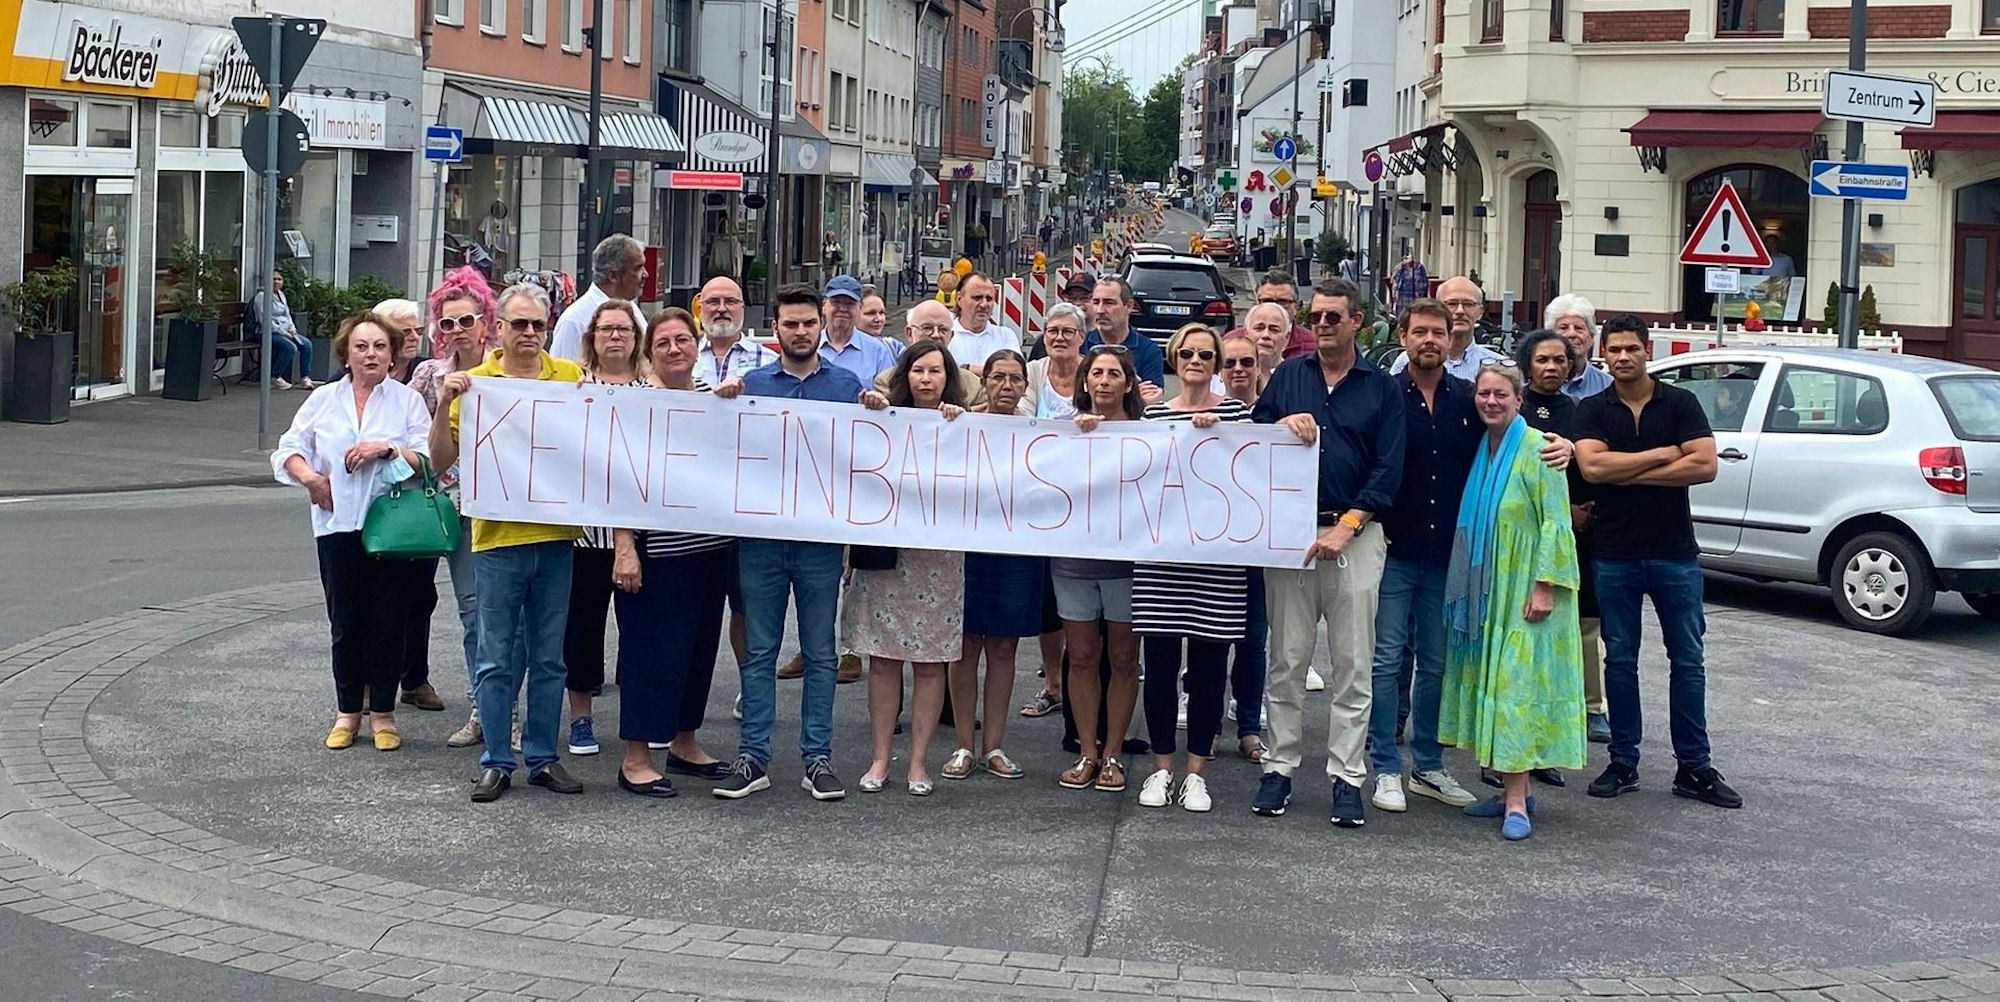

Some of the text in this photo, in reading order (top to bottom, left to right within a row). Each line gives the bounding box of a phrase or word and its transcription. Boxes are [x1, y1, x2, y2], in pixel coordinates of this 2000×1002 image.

[70, 25, 162, 83] Bäckerei
[1927, 71, 1956, 93] &
[986, 79, 996, 143] HOTEL
[1847, 87, 1904, 109] Zentrum
[323, 107, 384, 141] Immobilien
[1839, 175, 1903, 188] Einbahnstraße
